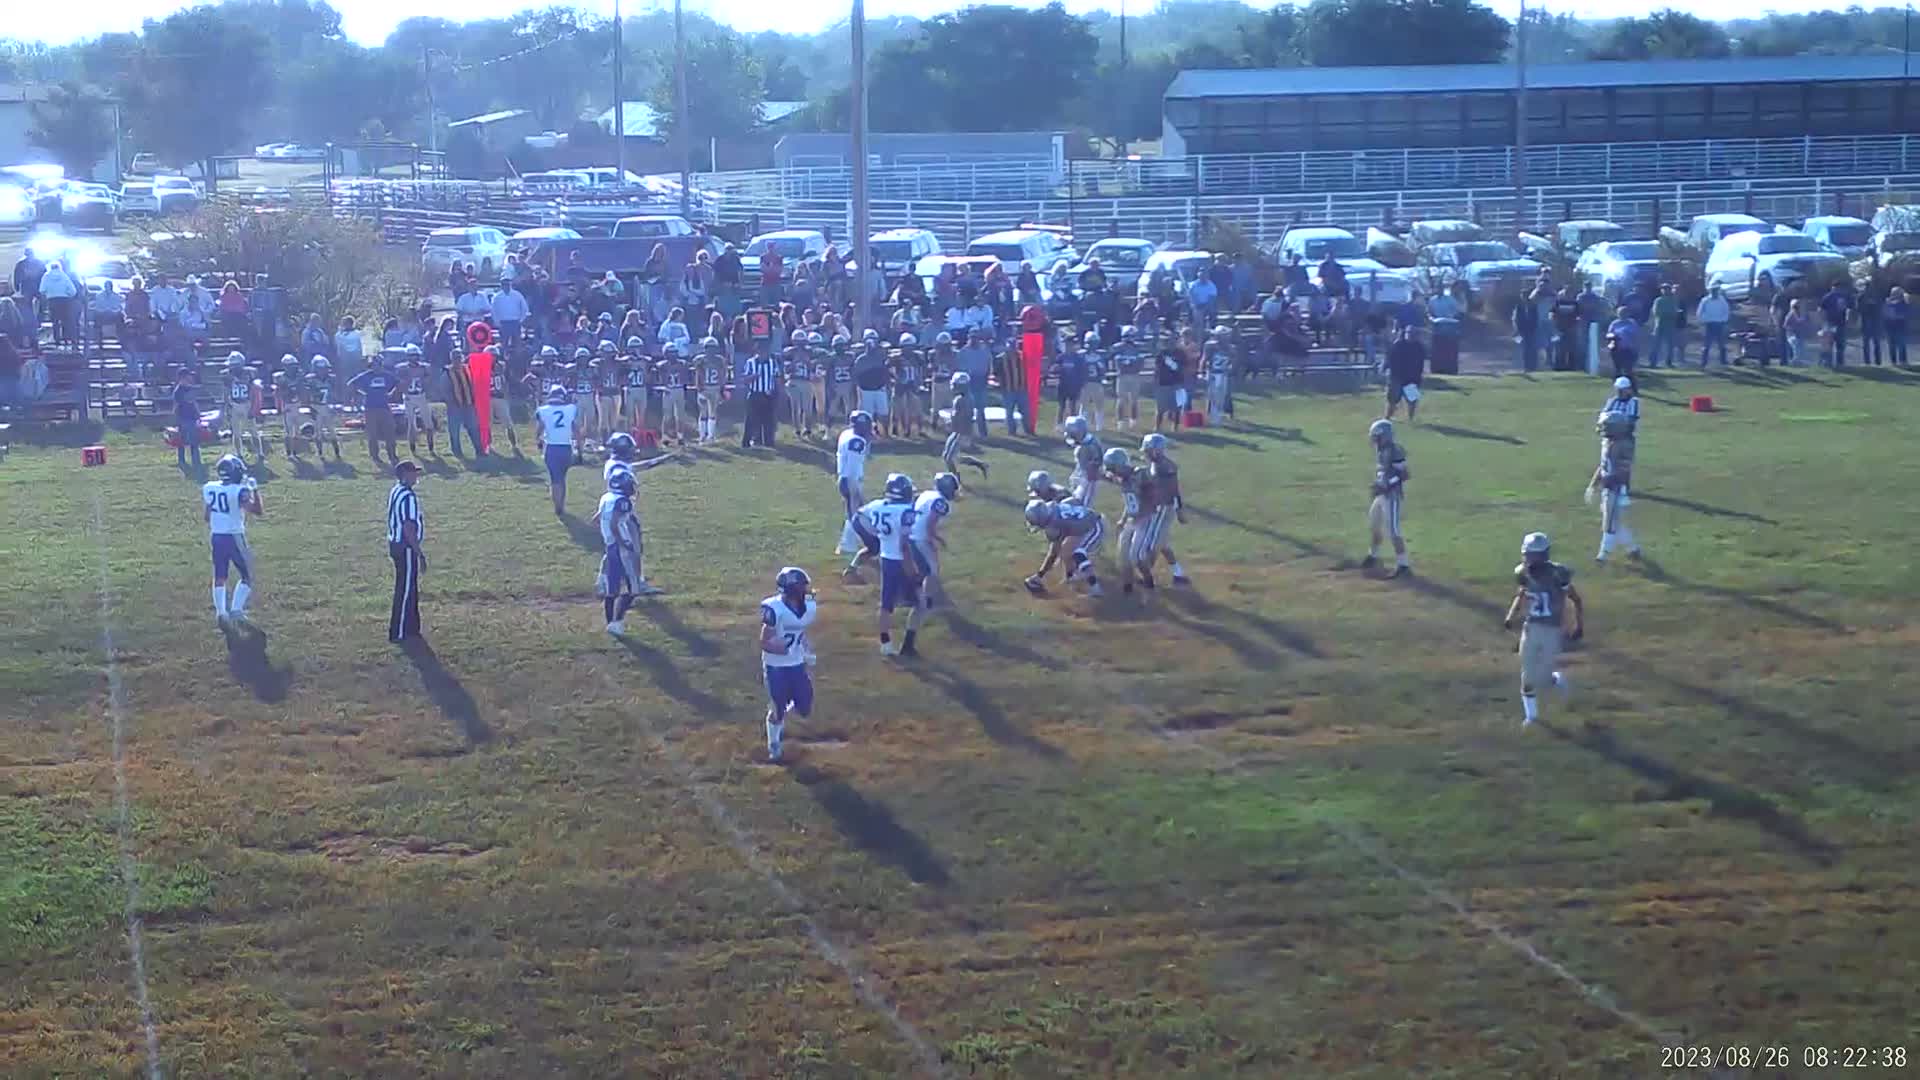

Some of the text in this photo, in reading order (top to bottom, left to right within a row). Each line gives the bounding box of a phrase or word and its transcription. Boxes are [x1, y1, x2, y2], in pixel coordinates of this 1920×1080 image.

[751, 312, 769, 335] 3
[704, 367, 719, 384] 12
[231, 382, 248, 398] 82
[319, 388, 329, 402] 7
[552, 410, 566, 428] 2
[208, 490, 230, 514] 20
[1526, 591, 1552, 617] 21
